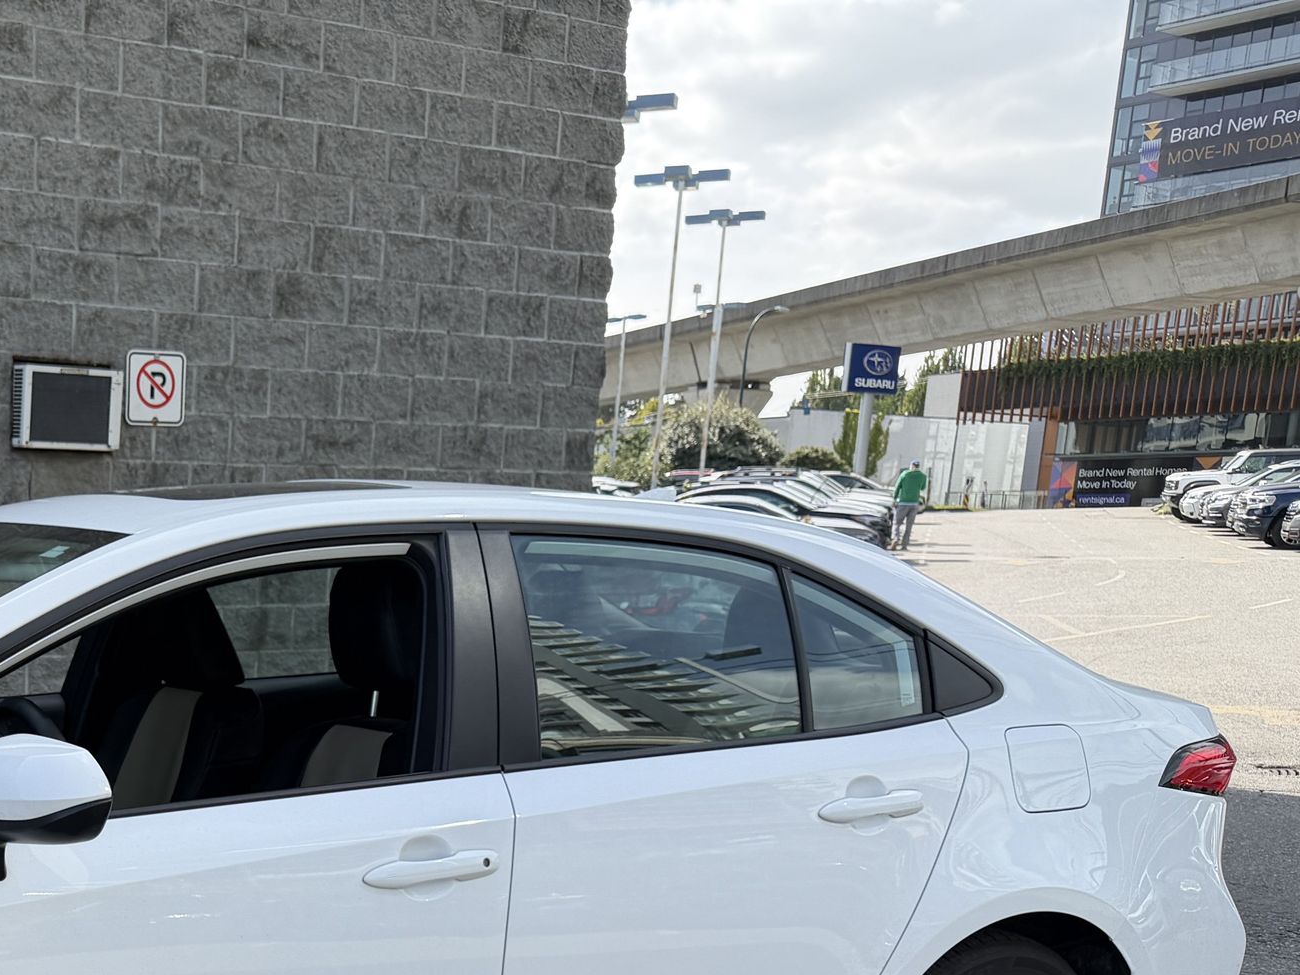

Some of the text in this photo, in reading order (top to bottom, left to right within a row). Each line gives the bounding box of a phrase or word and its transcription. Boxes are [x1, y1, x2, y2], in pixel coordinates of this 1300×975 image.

[1170, 109, 1300, 143] Brand New Re
[1167, 141, 1240, 165] MOVE-IN
[854, 377, 895, 390] SUBARU
[1078, 467, 1105, 478] Brand
[1105, 468, 1126, 477] New
[1126, 467, 1155, 477] Rental
[1077, 478, 1137, 490] Move In Today
